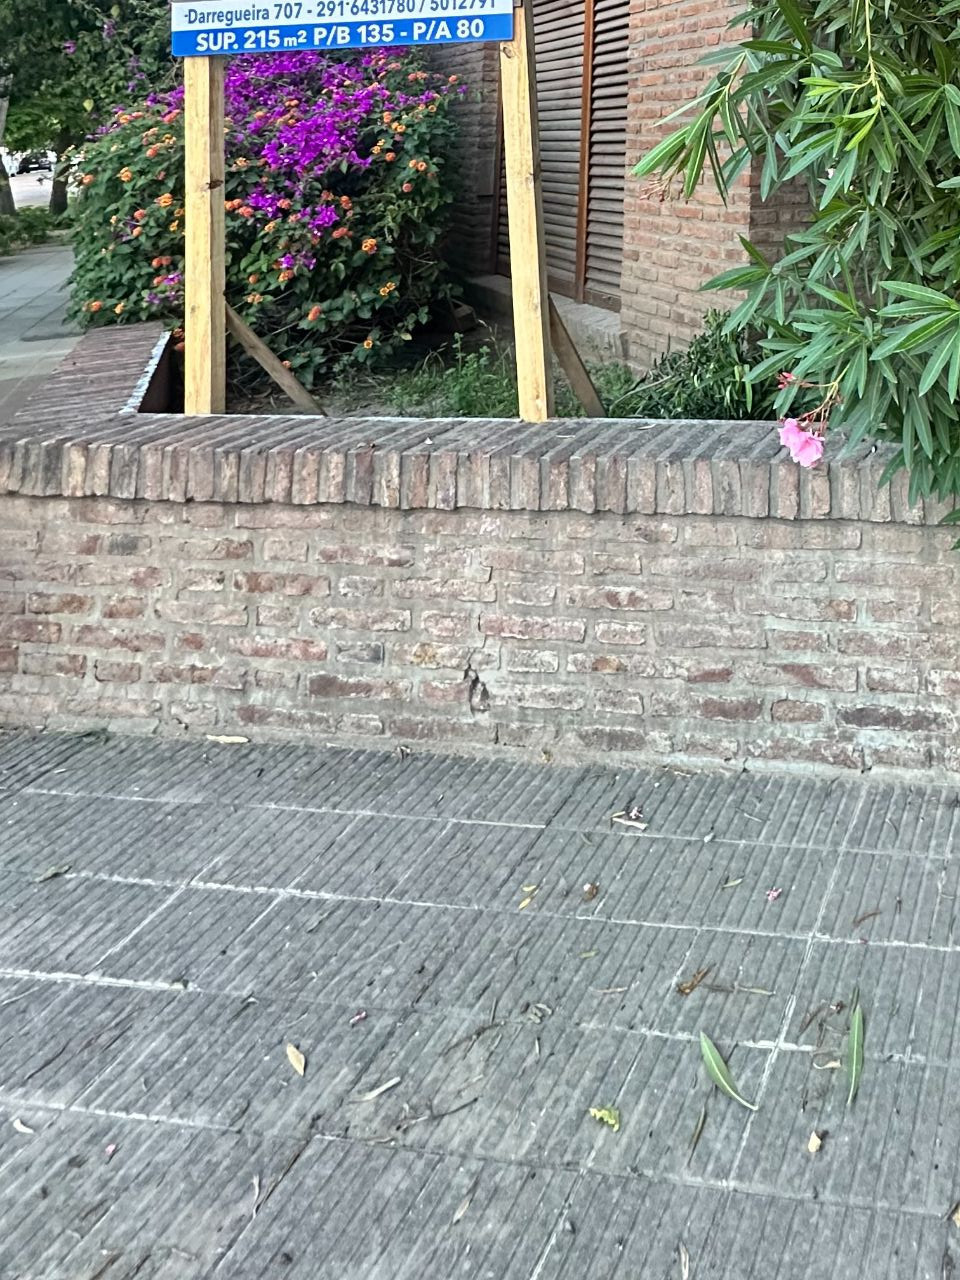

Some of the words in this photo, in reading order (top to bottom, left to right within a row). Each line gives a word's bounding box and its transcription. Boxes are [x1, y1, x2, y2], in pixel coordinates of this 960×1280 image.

[274, 2, 303, 19] 707
[195, 32, 239, 52] SUP.
[243, 29, 281, 49] 215
[313, 25, 351, 46] P/B
[356, 23, 395, 43] 135
[413, 20, 452, 40] P/A
[456, 18, 485, 38] 80
